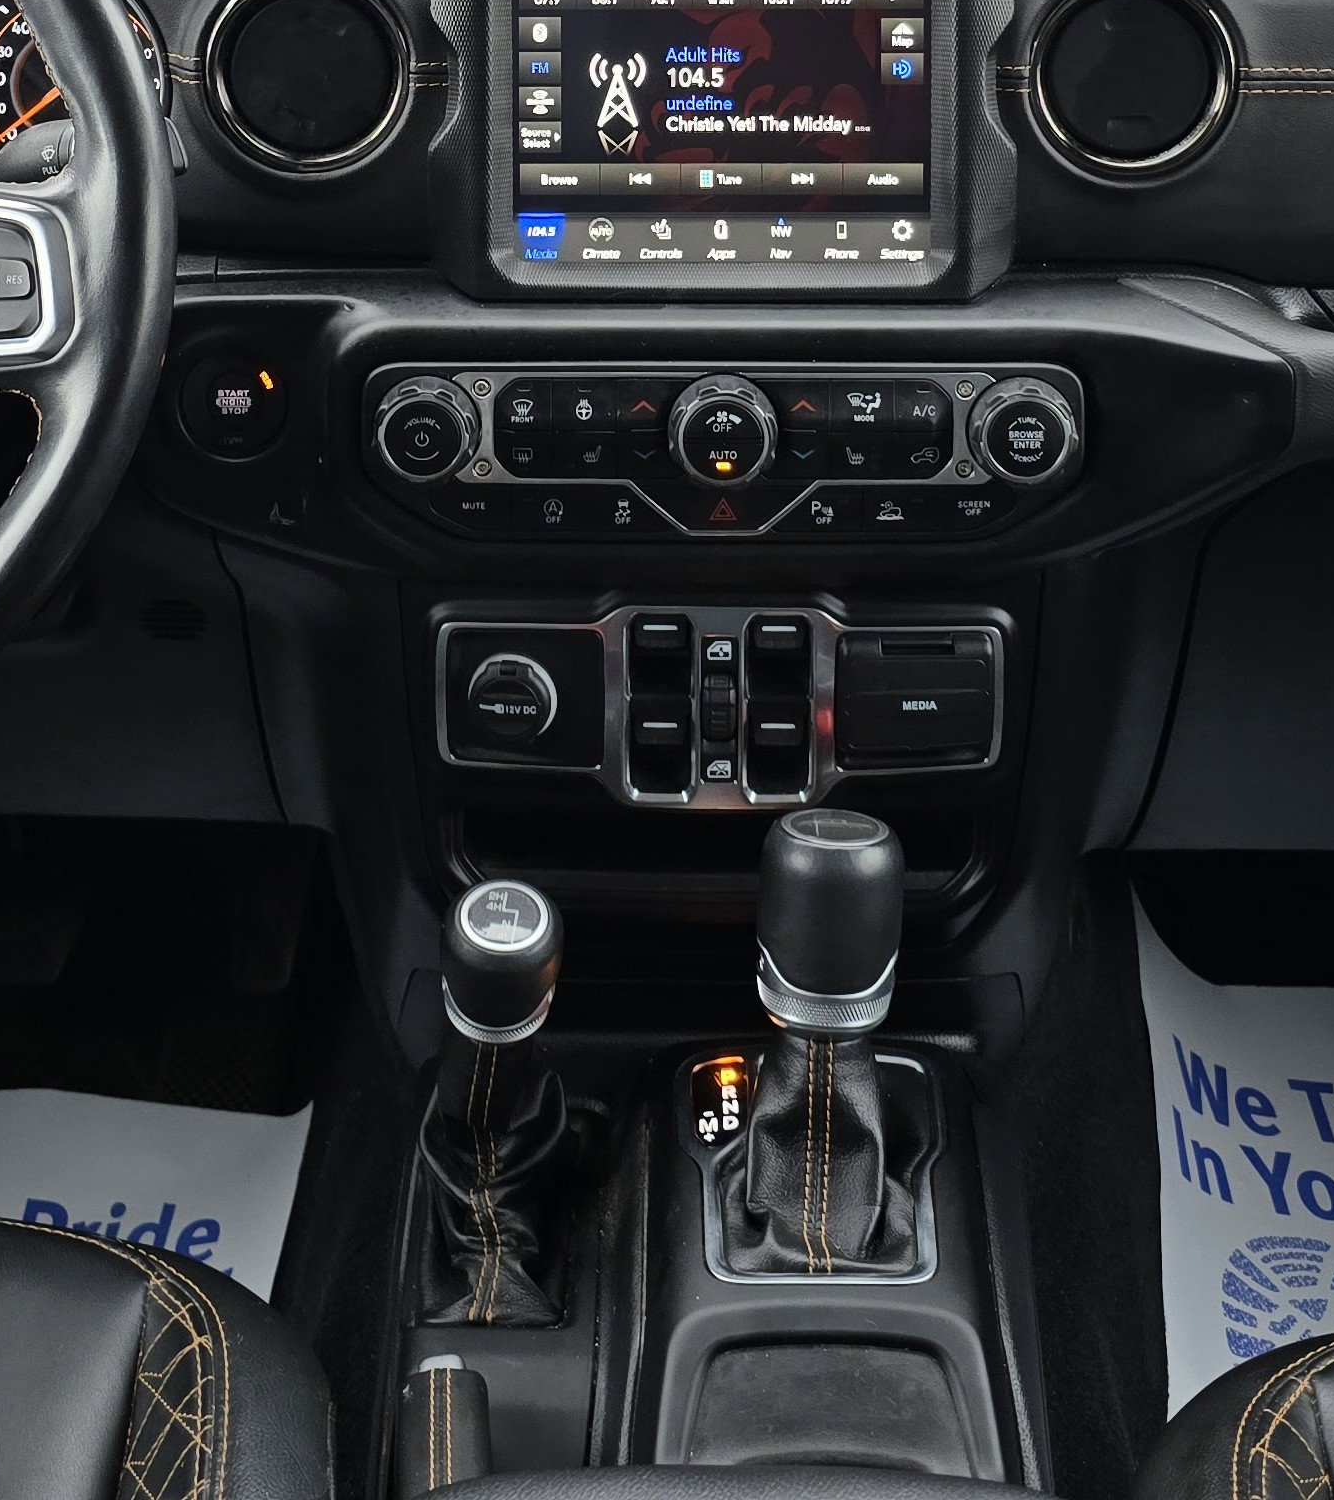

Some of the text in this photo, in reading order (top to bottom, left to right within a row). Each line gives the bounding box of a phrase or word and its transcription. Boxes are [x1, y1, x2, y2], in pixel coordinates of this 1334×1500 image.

[12, 21, 30, 35] 40
[891, 36, 914, 48] Map
[665, 47, 742, 63] Adult Hits
[530, 62, 550, 74] FM
[666, 67, 725, 88] 104.5
[666, 95, 734, 112] undefine
[665, 115, 852, 136] Christie Yeti The Midday
[7, 128, 17, 140] 0
[520, 127, 552, 138] Source
[522, 138, 551, 149] Select
[42, 165, 59, 175] PULL
[540, 174, 578, 186] Browse
[717, 174, 742, 186] Tune
[867, 173, 899, 186] Audio
[770, 225, 792, 238] NW
[639, 248, 683, 260] Controls
[706, 248, 736, 261] Apps
[770, 248, 792, 260] Nav
[824, 248, 860, 260] Phone
[880, 248, 925, 262] Settings
[6, 275, 23, 284] RES
[218, 389, 249, 397] START
[222, 407, 248, 415] STOP
[913, 405, 936, 417] A/C
[407, 417, 436, 427] VOLUME
[854, 414, 875, 422] MODE
[712, 423, 733, 433] OFF
[1008, 430, 1044, 439] BROWSE
[1013, 441, 1042, 449] ENTER
[709, 451, 738, 460] AUTO
[462, 502, 486, 510] MUTE
[965, 508, 981, 516] OFF
[545, 516, 562, 524] OFF
[615, 516, 631, 525] OFF
[815, 517, 832, 525] OFF
[505, 705, 537, 715] 12V DC
[902, 700, 938, 711] MEDIA
[720, 1068, 736, 1085] P
[1172, 1032, 1282, 1138] We
[721, 1085, 737, 1099] R
[722, 1100, 739, 1114] N
[699, 1118, 718, 1134] M
[722, 1116, 739, 1130] D
[1172, 1102, 1234, 1204] In
